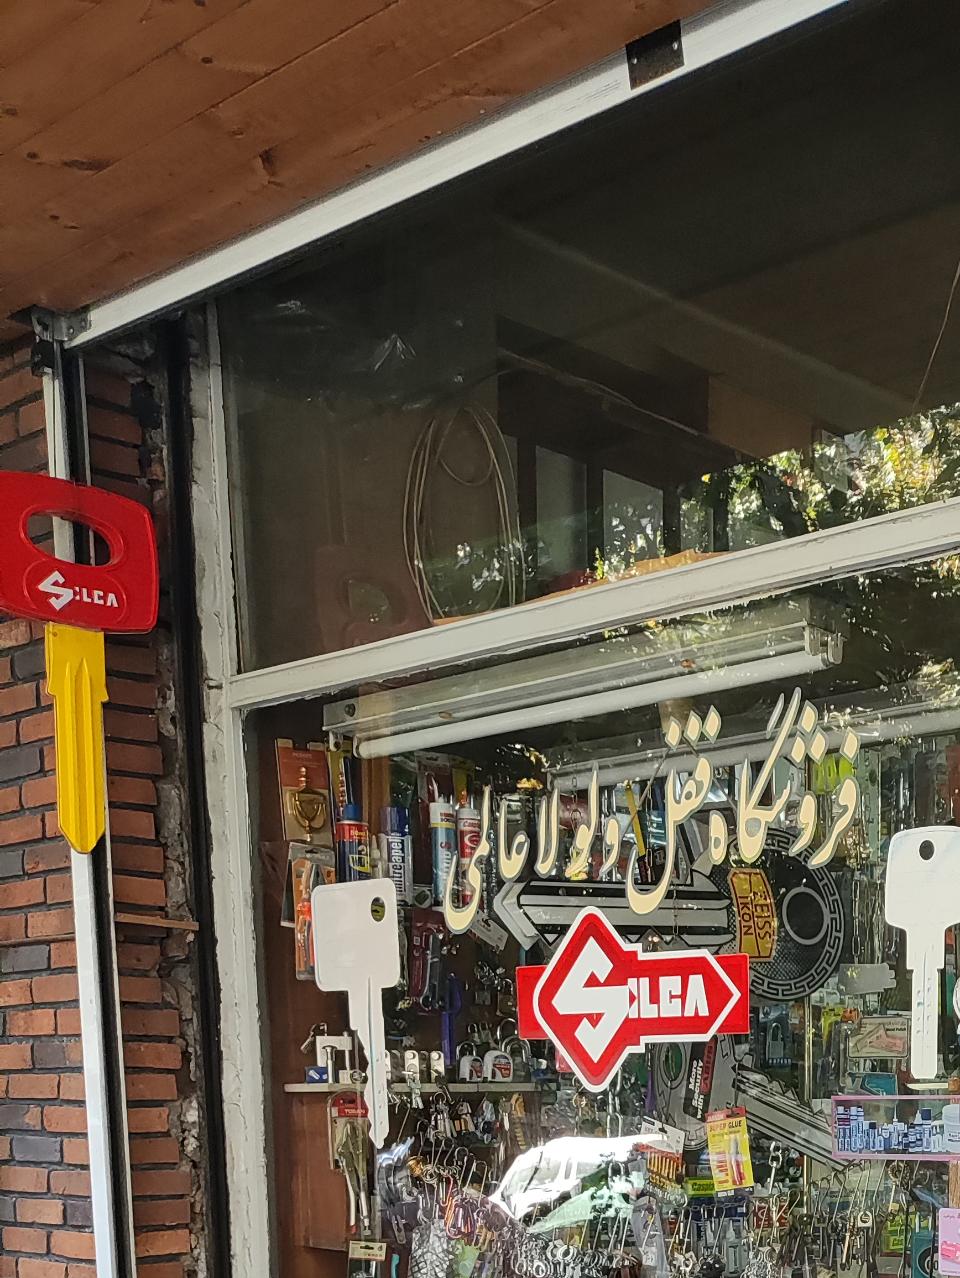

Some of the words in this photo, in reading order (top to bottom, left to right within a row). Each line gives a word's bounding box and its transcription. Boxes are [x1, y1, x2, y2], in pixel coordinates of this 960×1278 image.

[37, 570, 119, 611] SILCA
[626, 704, 722, 915] قفل
[708, 687, 861, 869] فروشگاه
[738, 895, 754, 936] IKON
[552, 936, 709, 1064] SILCA
